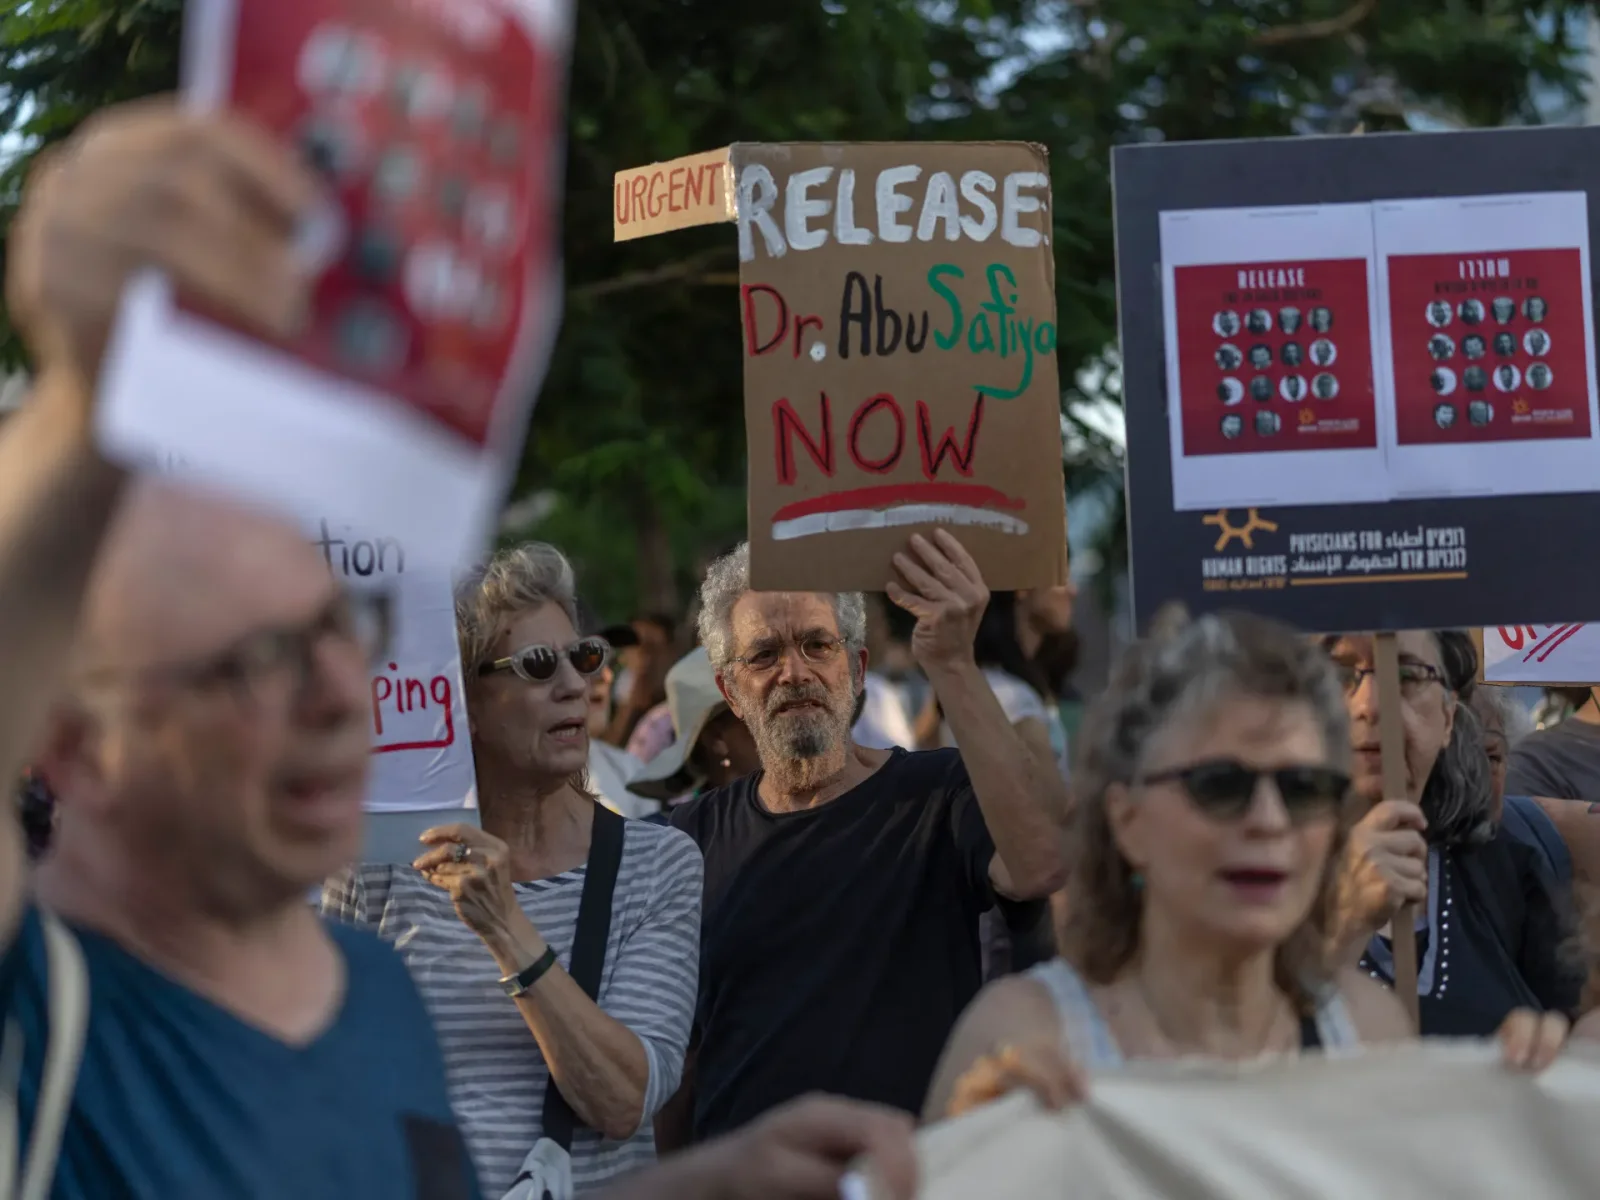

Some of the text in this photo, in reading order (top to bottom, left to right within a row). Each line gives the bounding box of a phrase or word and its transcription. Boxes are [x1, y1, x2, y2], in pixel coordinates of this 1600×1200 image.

[615, 162, 723, 224] URGENT
[738, 164, 1049, 262] RELEASE
[1238, 268, 1304, 289] RELEASE
[743, 284, 826, 361] Dr.
[838, 271, 929, 358] Abu
[772, 390, 985, 485] NOW
[311, 518, 404, 576] tion
[1290, 530, 1383, 553] PHYSICIANS FOR
[370, 662, 455, 746] ping
